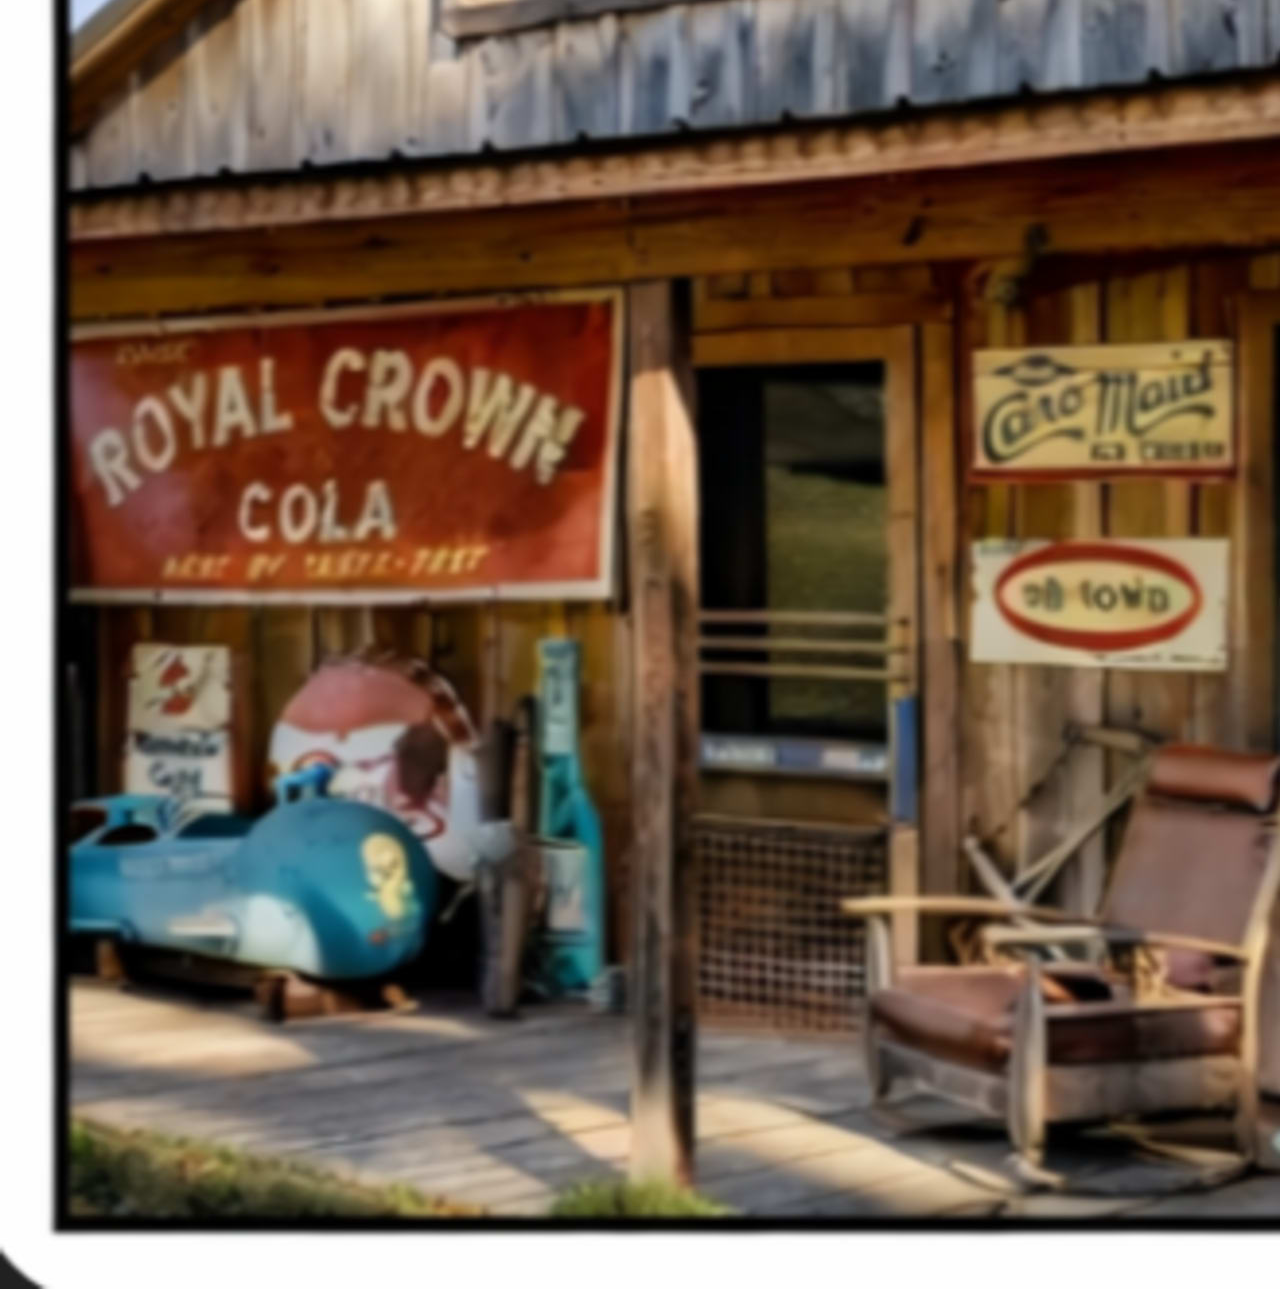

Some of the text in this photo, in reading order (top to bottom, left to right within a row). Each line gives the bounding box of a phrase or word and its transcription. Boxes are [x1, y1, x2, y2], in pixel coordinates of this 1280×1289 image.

[89, 348, 586, 508] ROYAL CROWN
[238, 479, 398, 544] COLA
